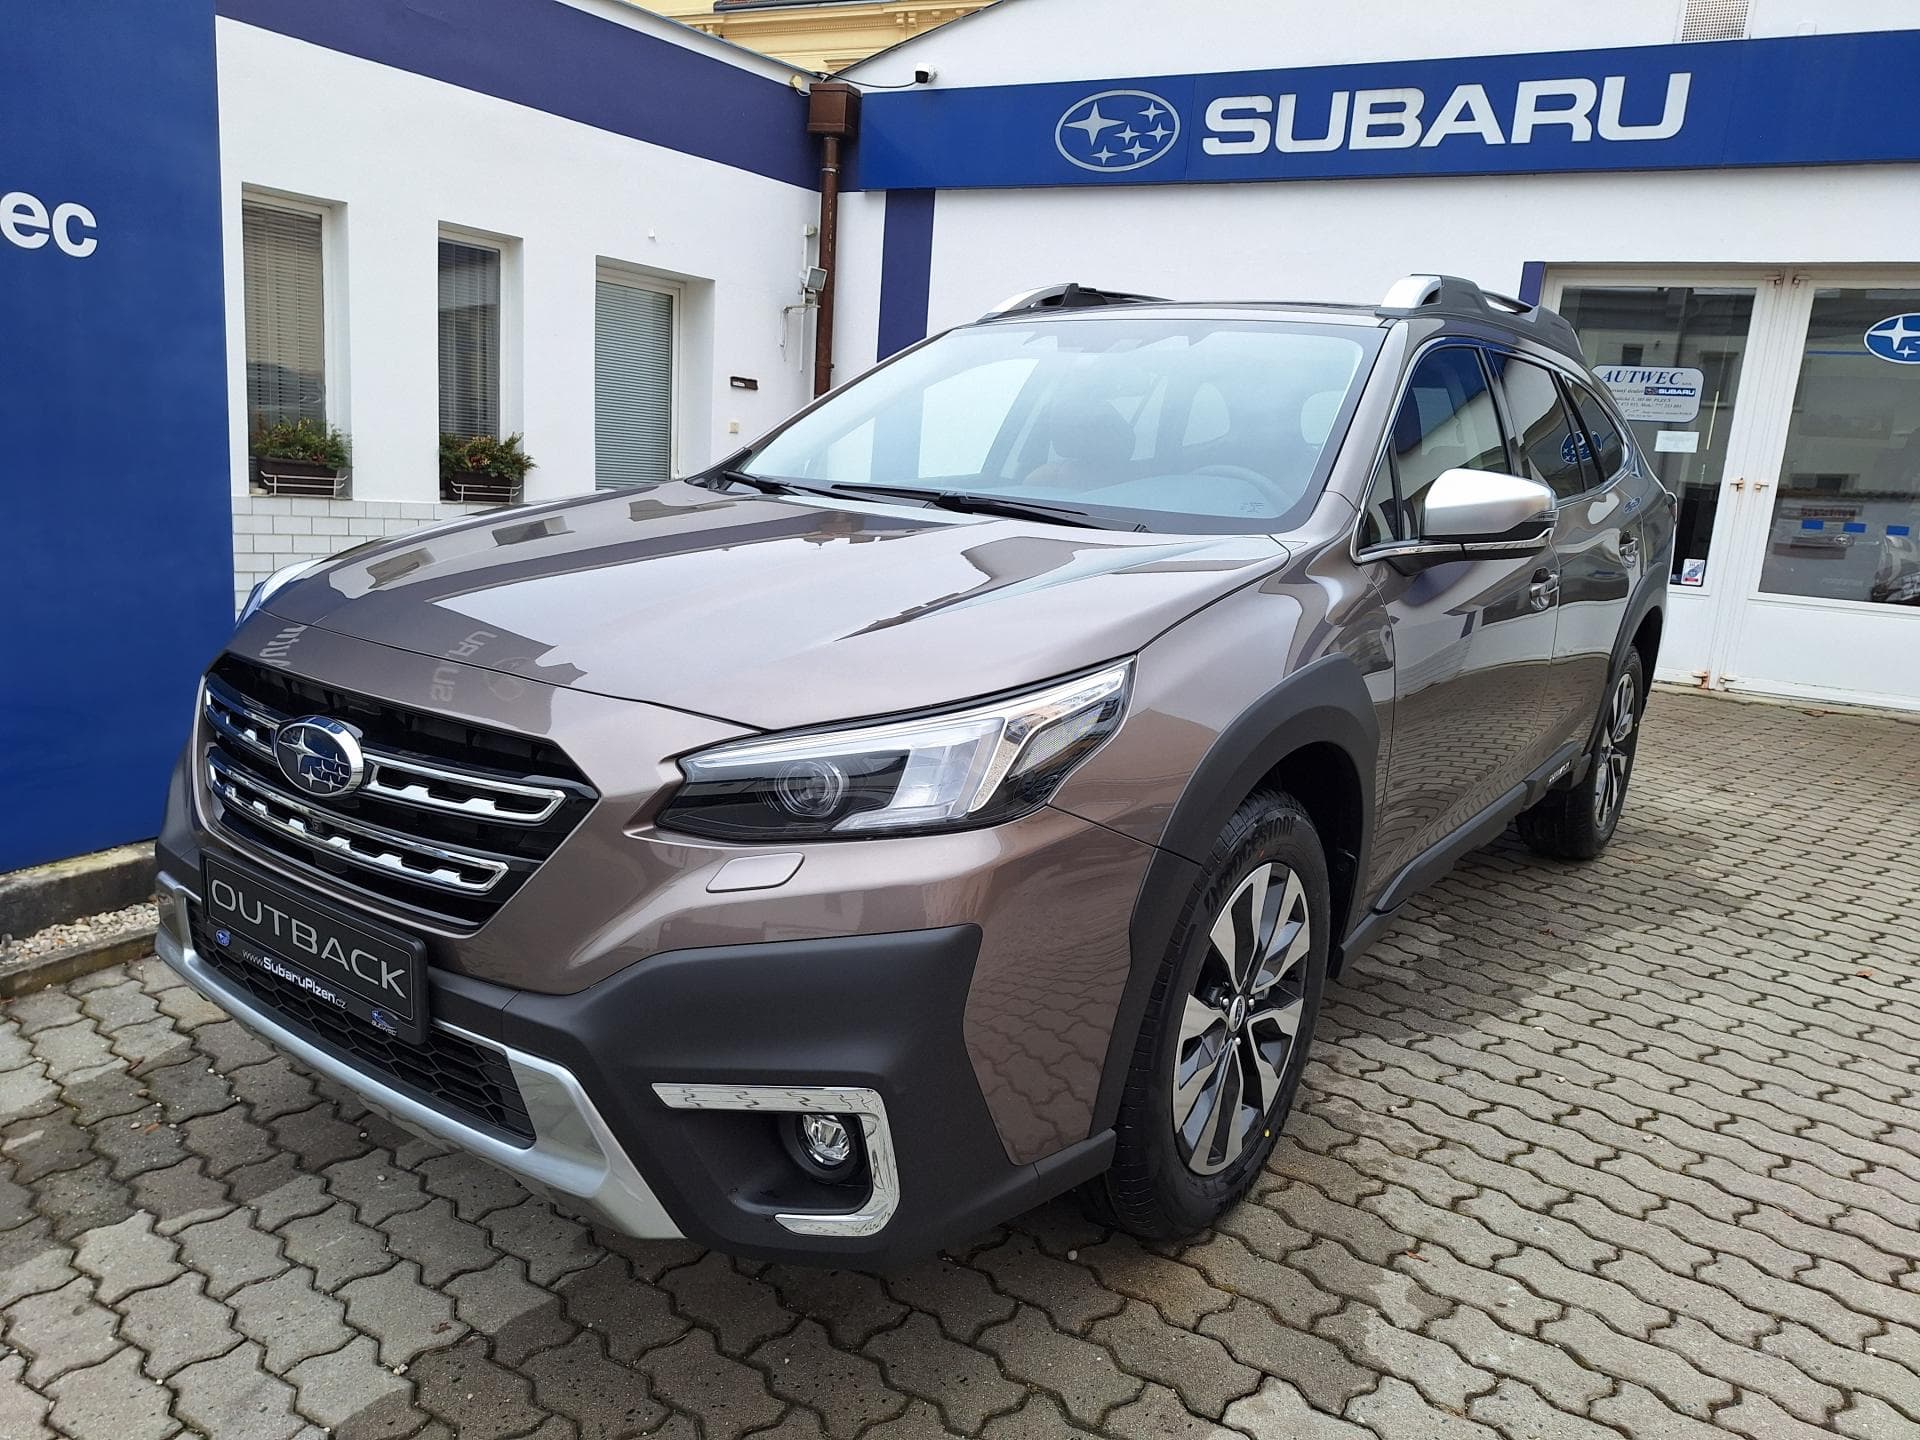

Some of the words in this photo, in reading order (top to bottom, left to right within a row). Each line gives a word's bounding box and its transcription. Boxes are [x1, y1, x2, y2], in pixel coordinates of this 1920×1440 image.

[1202, 72, 1691, 155] SUBARU
[0, 191, 98, 258] ec
[1602, 370, 1684, 385] AUTWEC
[1658, 388, 1695, 396] SUBARU
[211, 879, 407, 999] OUTBACK
